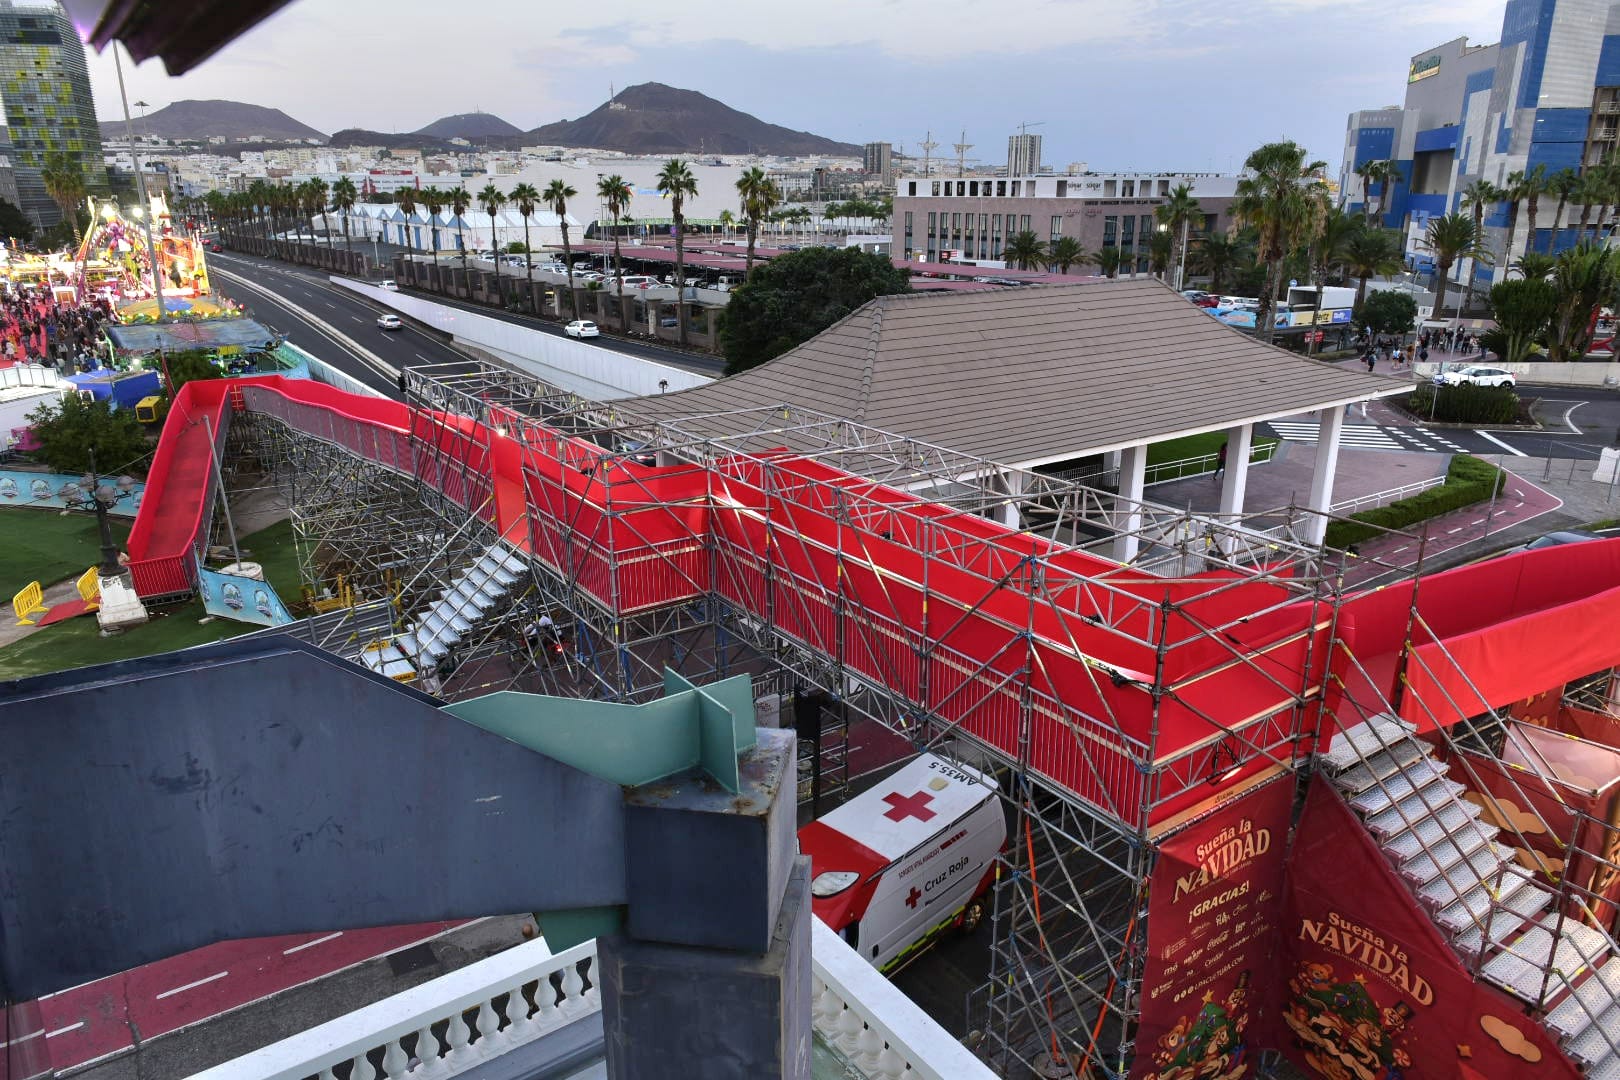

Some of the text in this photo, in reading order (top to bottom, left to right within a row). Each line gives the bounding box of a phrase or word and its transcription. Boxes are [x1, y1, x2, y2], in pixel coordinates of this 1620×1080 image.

[927, 761, 978, 786] AM35.5
[1196, 818, 1252, 862] Sueña la
[925, 871, 947, 892] Cruz
[949, 856, 969, 875] Roja
[1172, 829, 1271, 903] NAVIDAD
[1188, 880, 1250, 924] ¡GRACIAS!
[1328, 912, 1408, 964] Sueña la
[1298, 919, 1434, 1006] NAVIDAD
